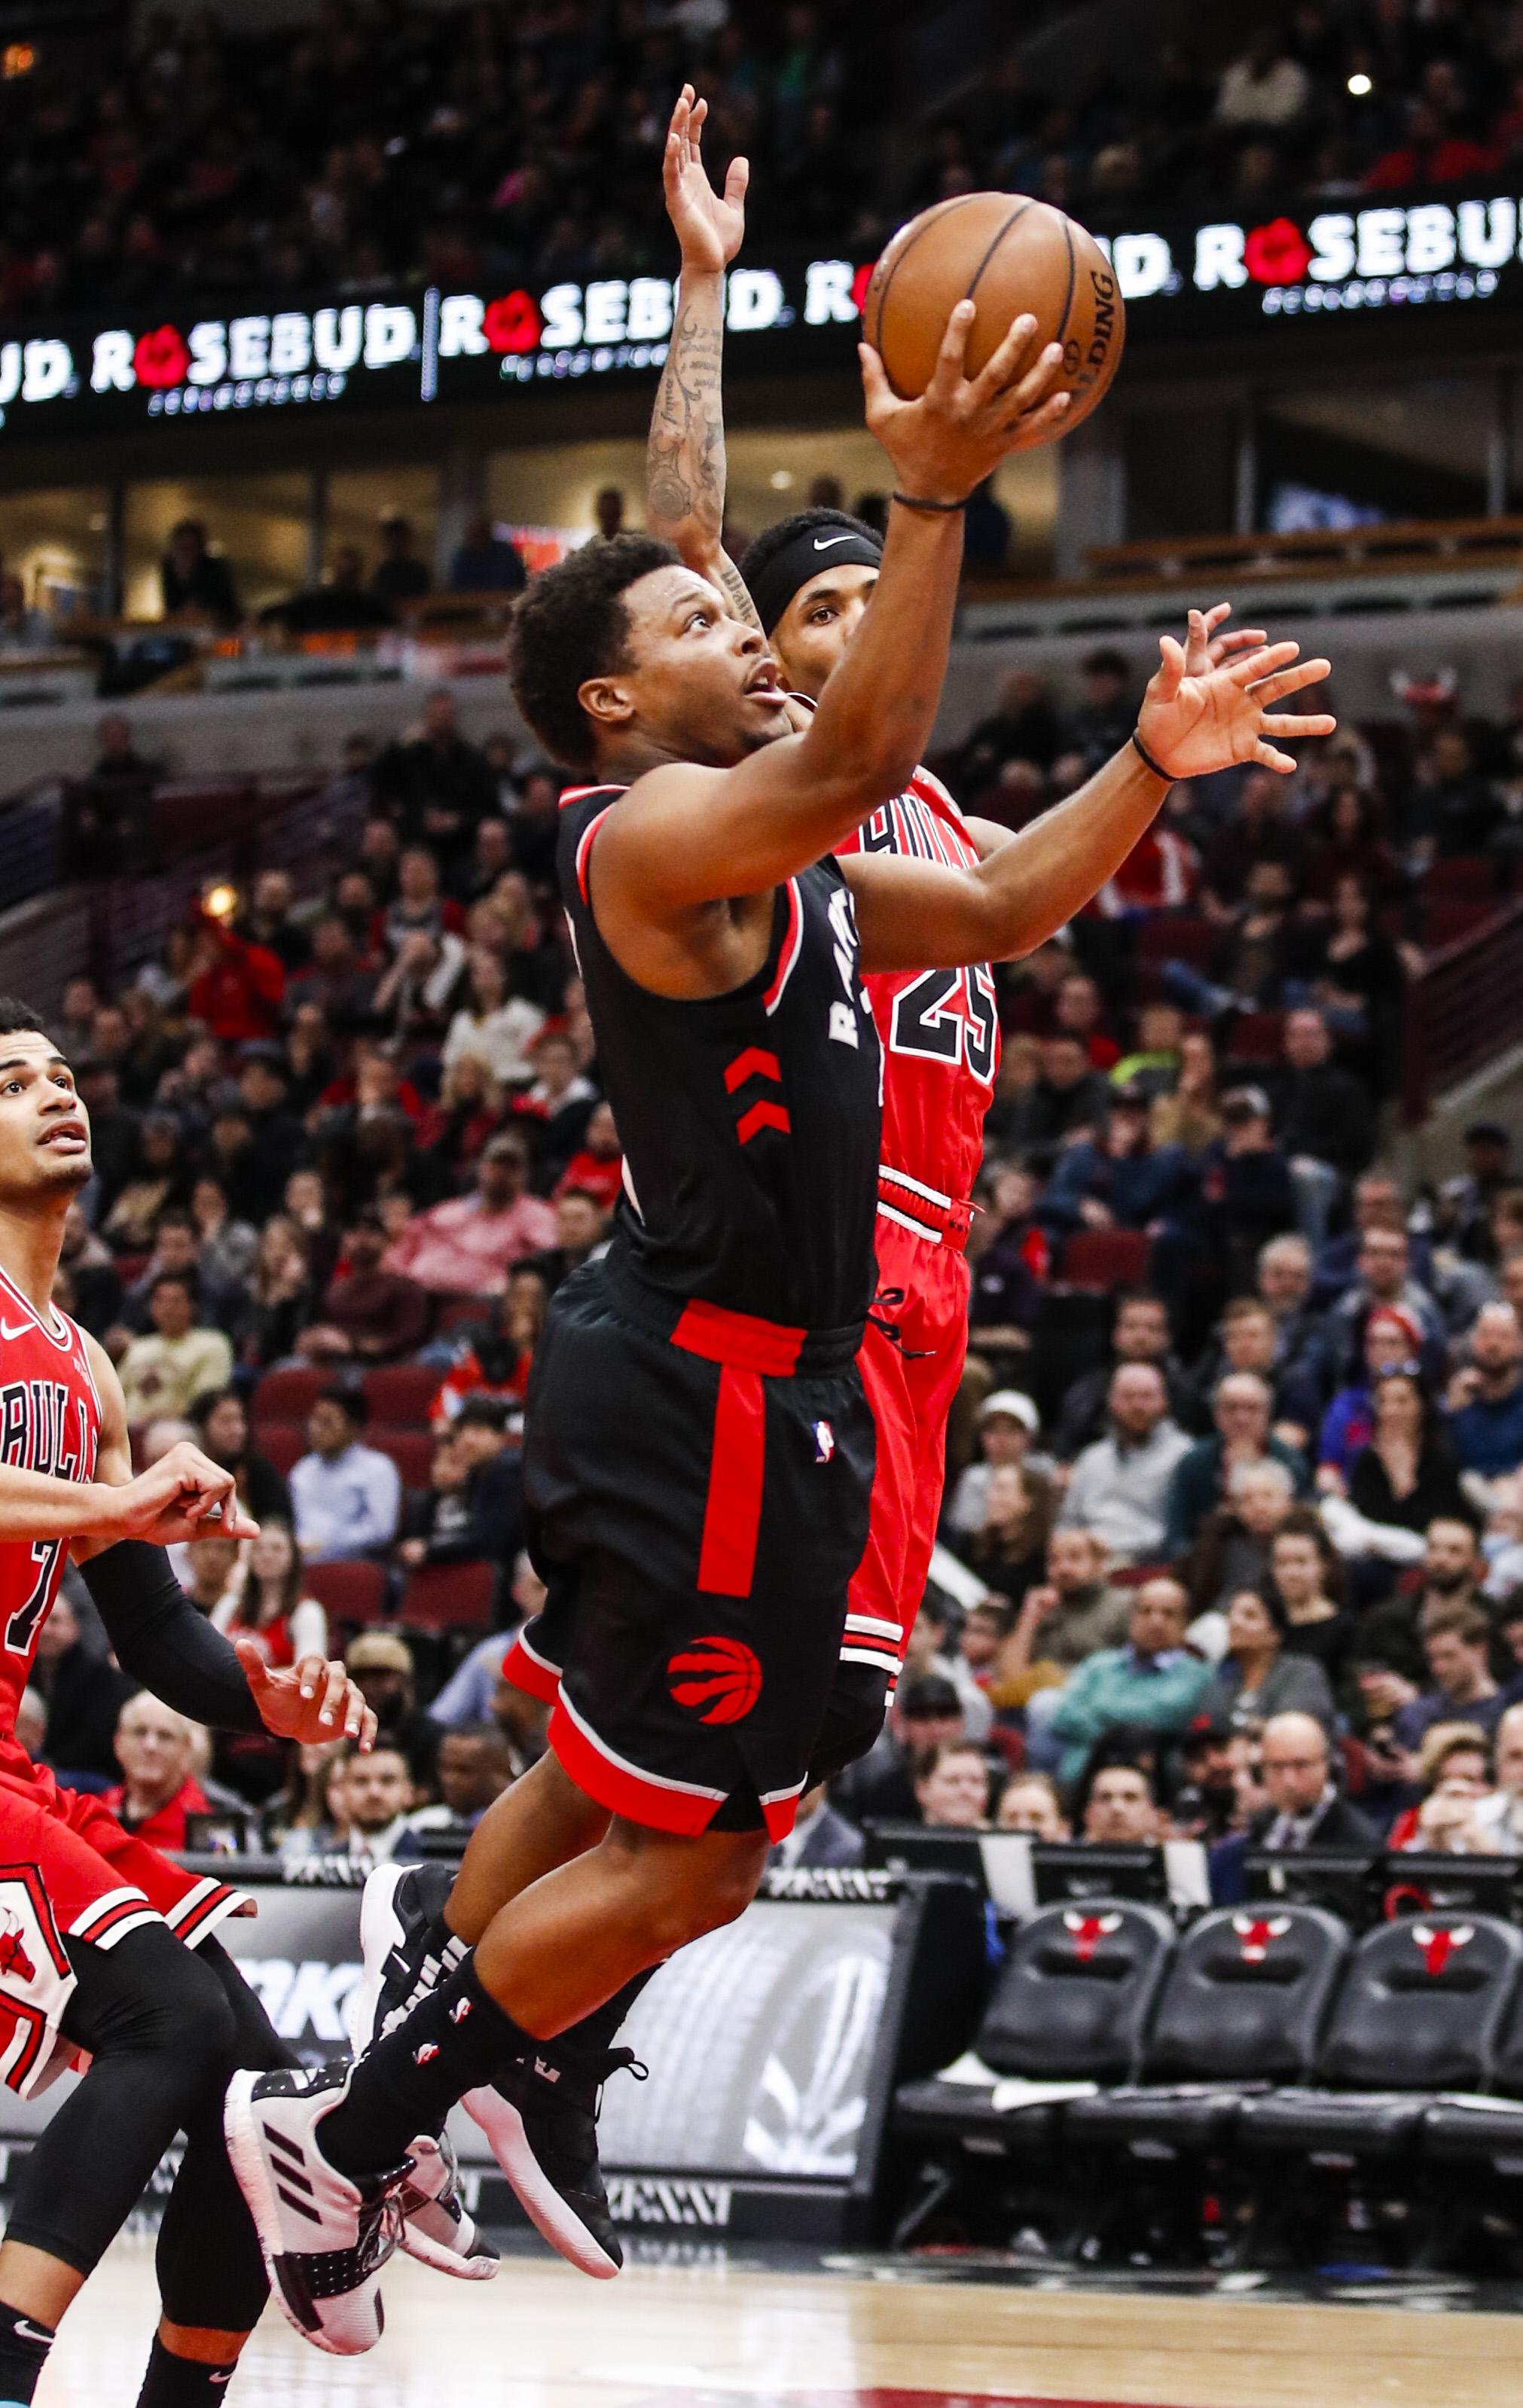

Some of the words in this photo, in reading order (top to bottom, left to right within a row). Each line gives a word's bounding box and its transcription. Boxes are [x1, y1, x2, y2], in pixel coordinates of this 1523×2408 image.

[1193, 197, 1523, 291] ROSEBU
[438, 268, 785, 357] ROSEBD
[890, 962, 997, 1085] 25
[5, 1538, 62, 1657] 7
